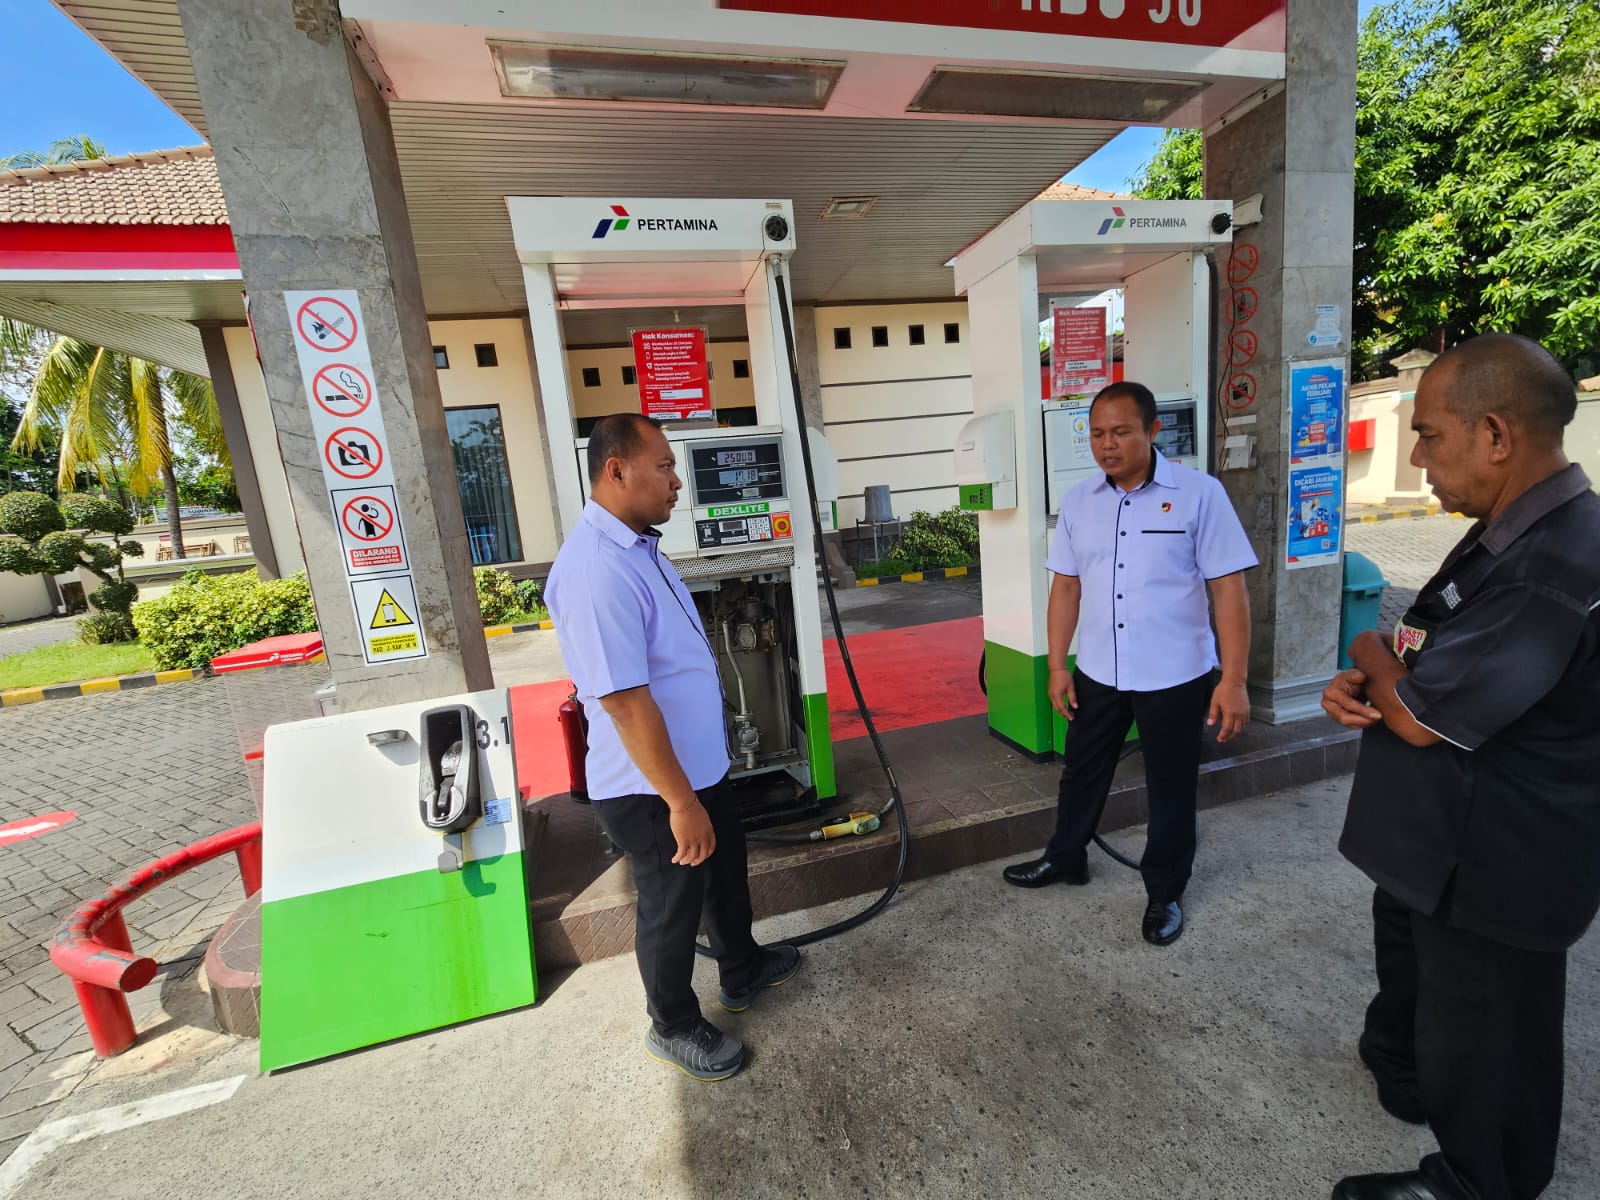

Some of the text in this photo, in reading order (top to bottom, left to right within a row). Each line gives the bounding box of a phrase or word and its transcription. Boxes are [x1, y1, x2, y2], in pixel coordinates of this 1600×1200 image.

[637, 218, 718, 231] PERTAMINA
[1129, 217, 1187, 228] PERTAMINA
[724, 452, 753, 464] 25000
[712, 503, 767, 518] DEXLITE
[353, 547, 398, 557] DILARANG
[476, 716, 510, 750] 3.1
